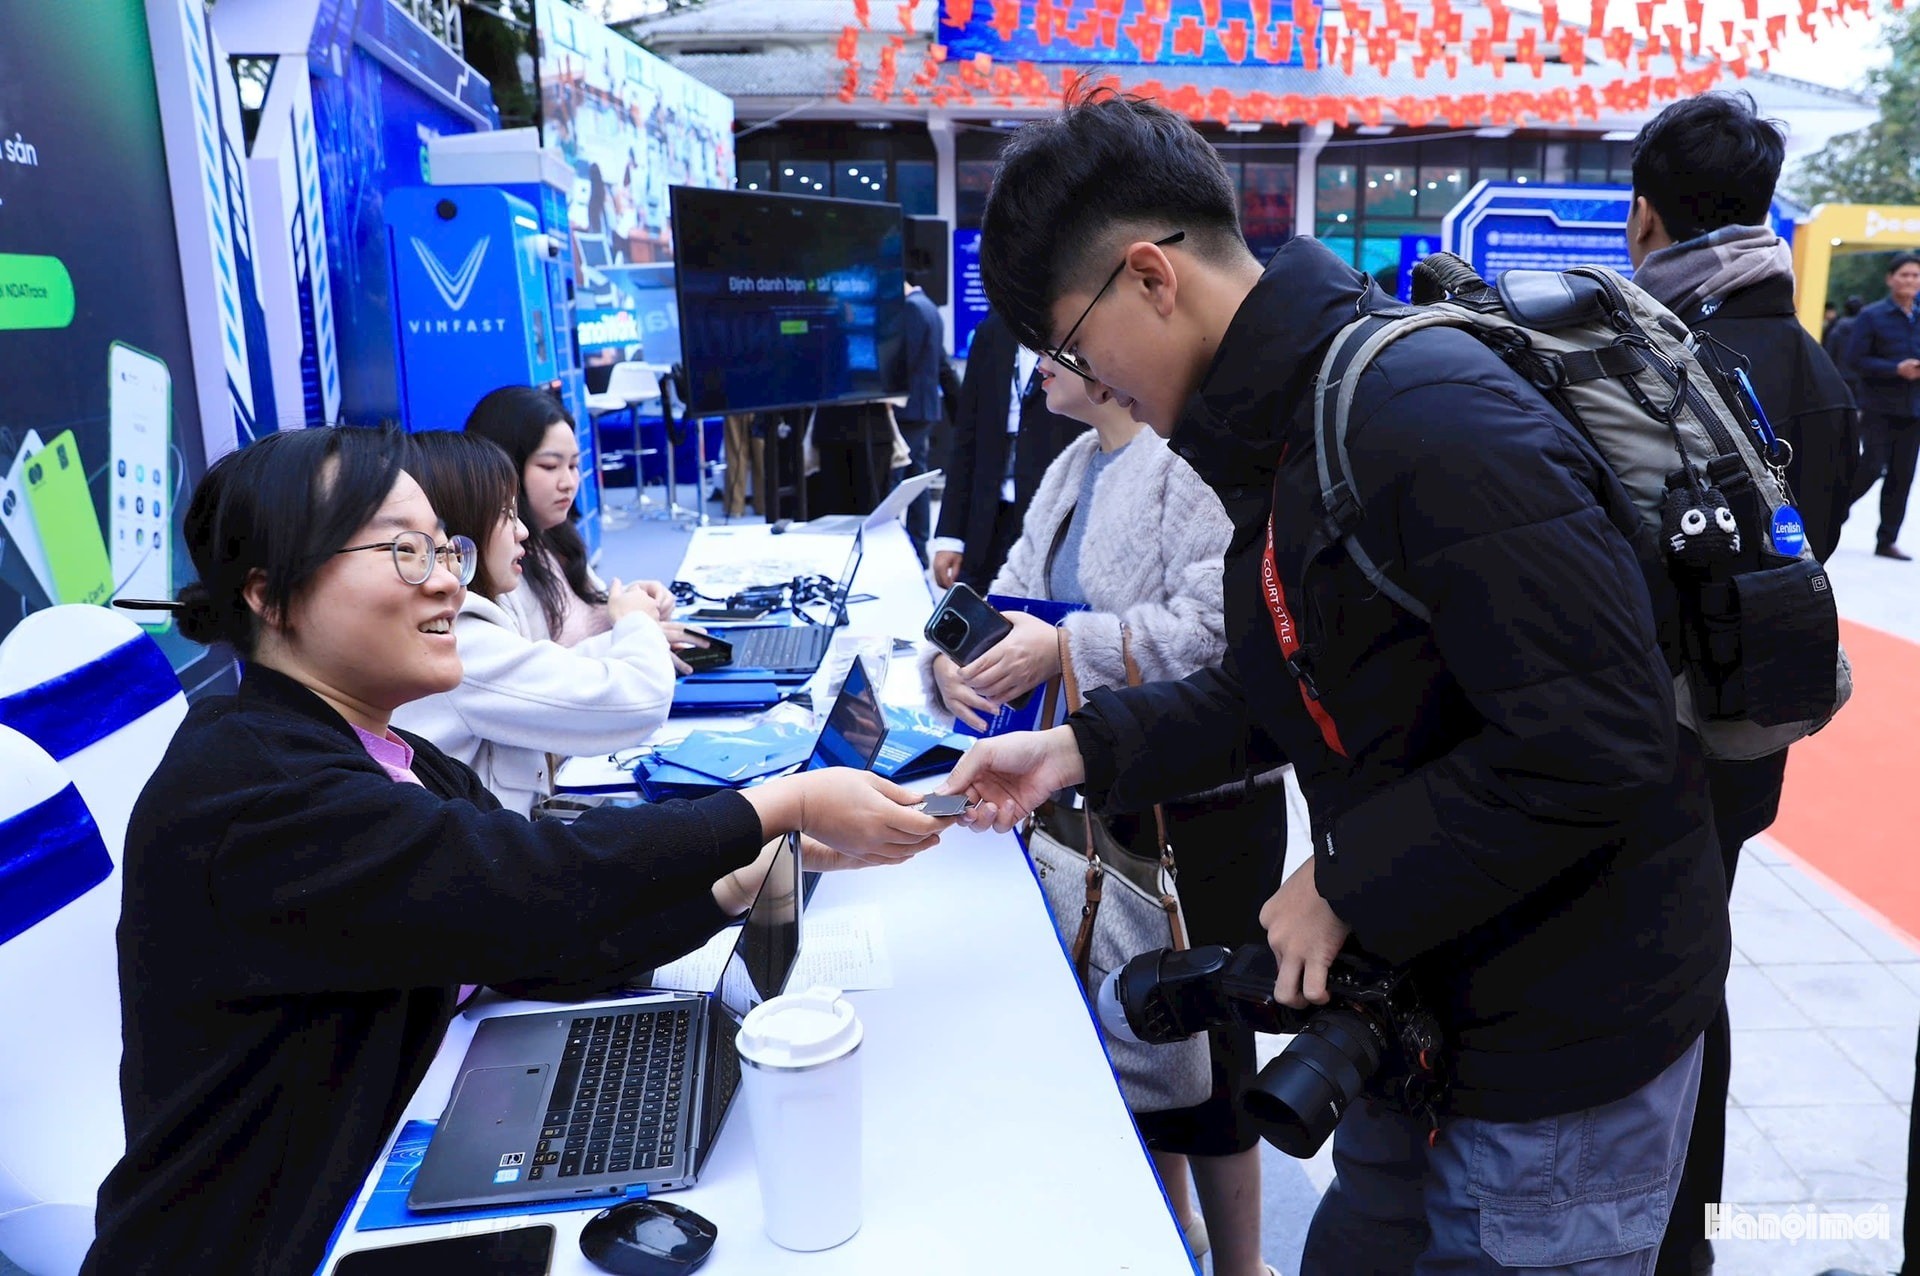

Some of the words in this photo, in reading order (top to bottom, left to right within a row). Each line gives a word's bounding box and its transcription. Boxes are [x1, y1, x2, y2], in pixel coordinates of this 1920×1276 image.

[5, 132, 39, 167] sản
[729, 277, 755, 294] Định
[756, 277, 784, 292] danh
[785, 277, 806, 295] bạn
[408, 318, 506, 334] VINFAST
[1263, 558, 1281, 603] COURT
[1274, 605, 1292, 644] STYLE
